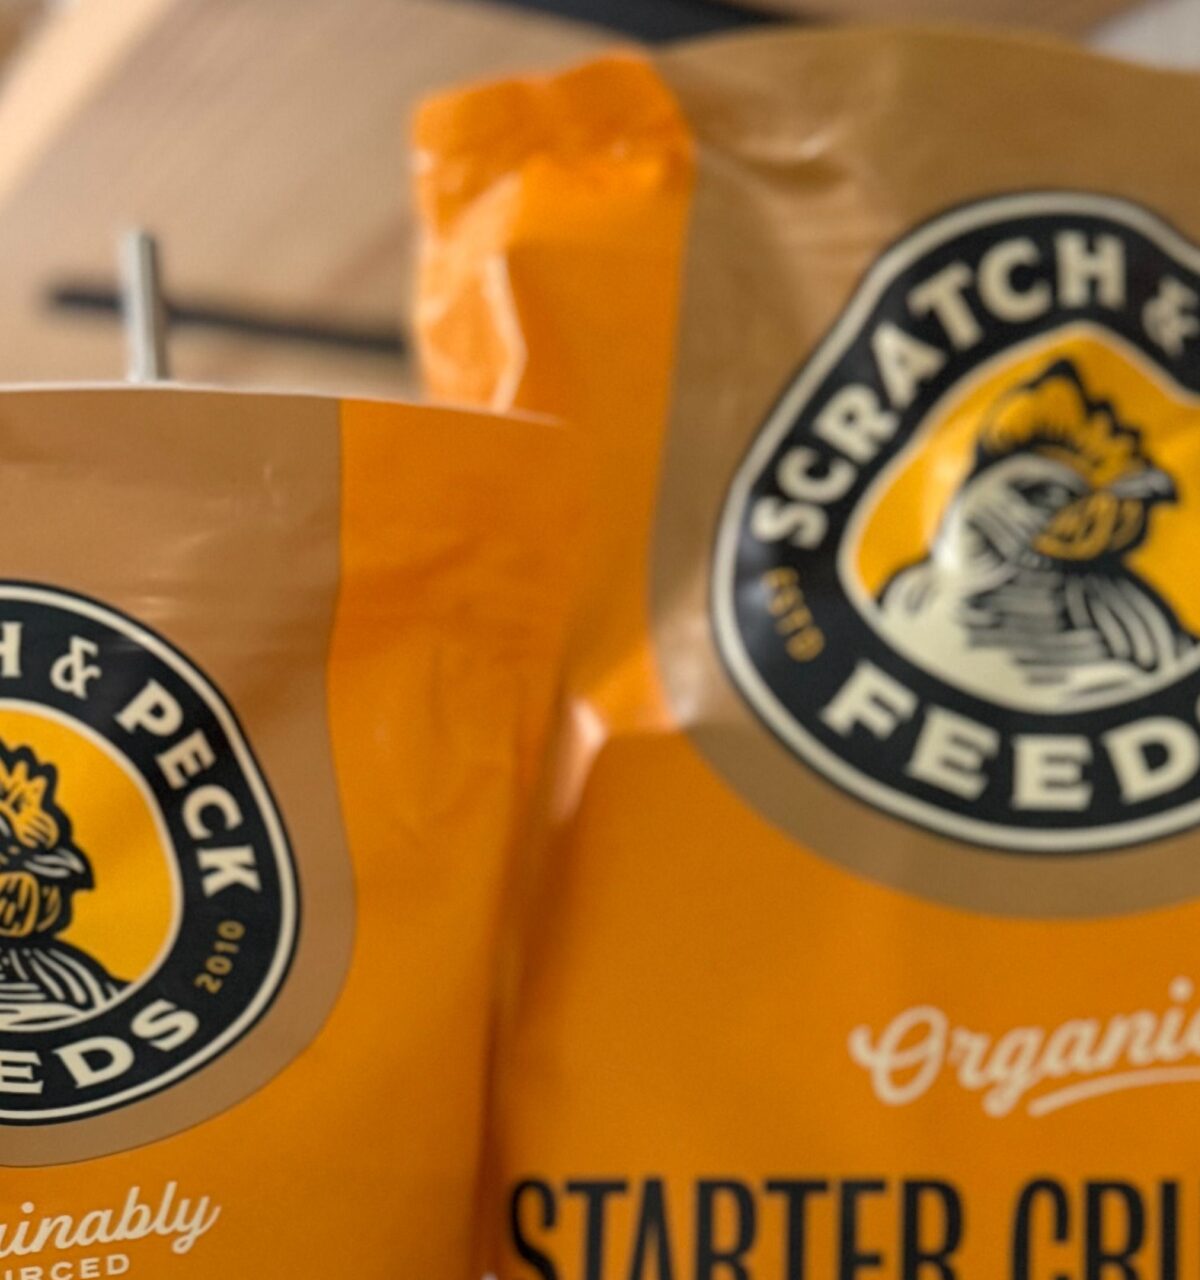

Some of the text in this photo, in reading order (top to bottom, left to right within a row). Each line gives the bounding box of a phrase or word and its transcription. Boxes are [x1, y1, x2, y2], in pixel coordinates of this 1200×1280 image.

[752, 230, 1127, 548] SCRATCH
[1141, 276, 1200, 356] &
[50, 635, 102, 699] &
[114, 679, 261, 897] PECK
[194, 921, 246, 993] 2010
[0, 1181, 221, 1258] inably
